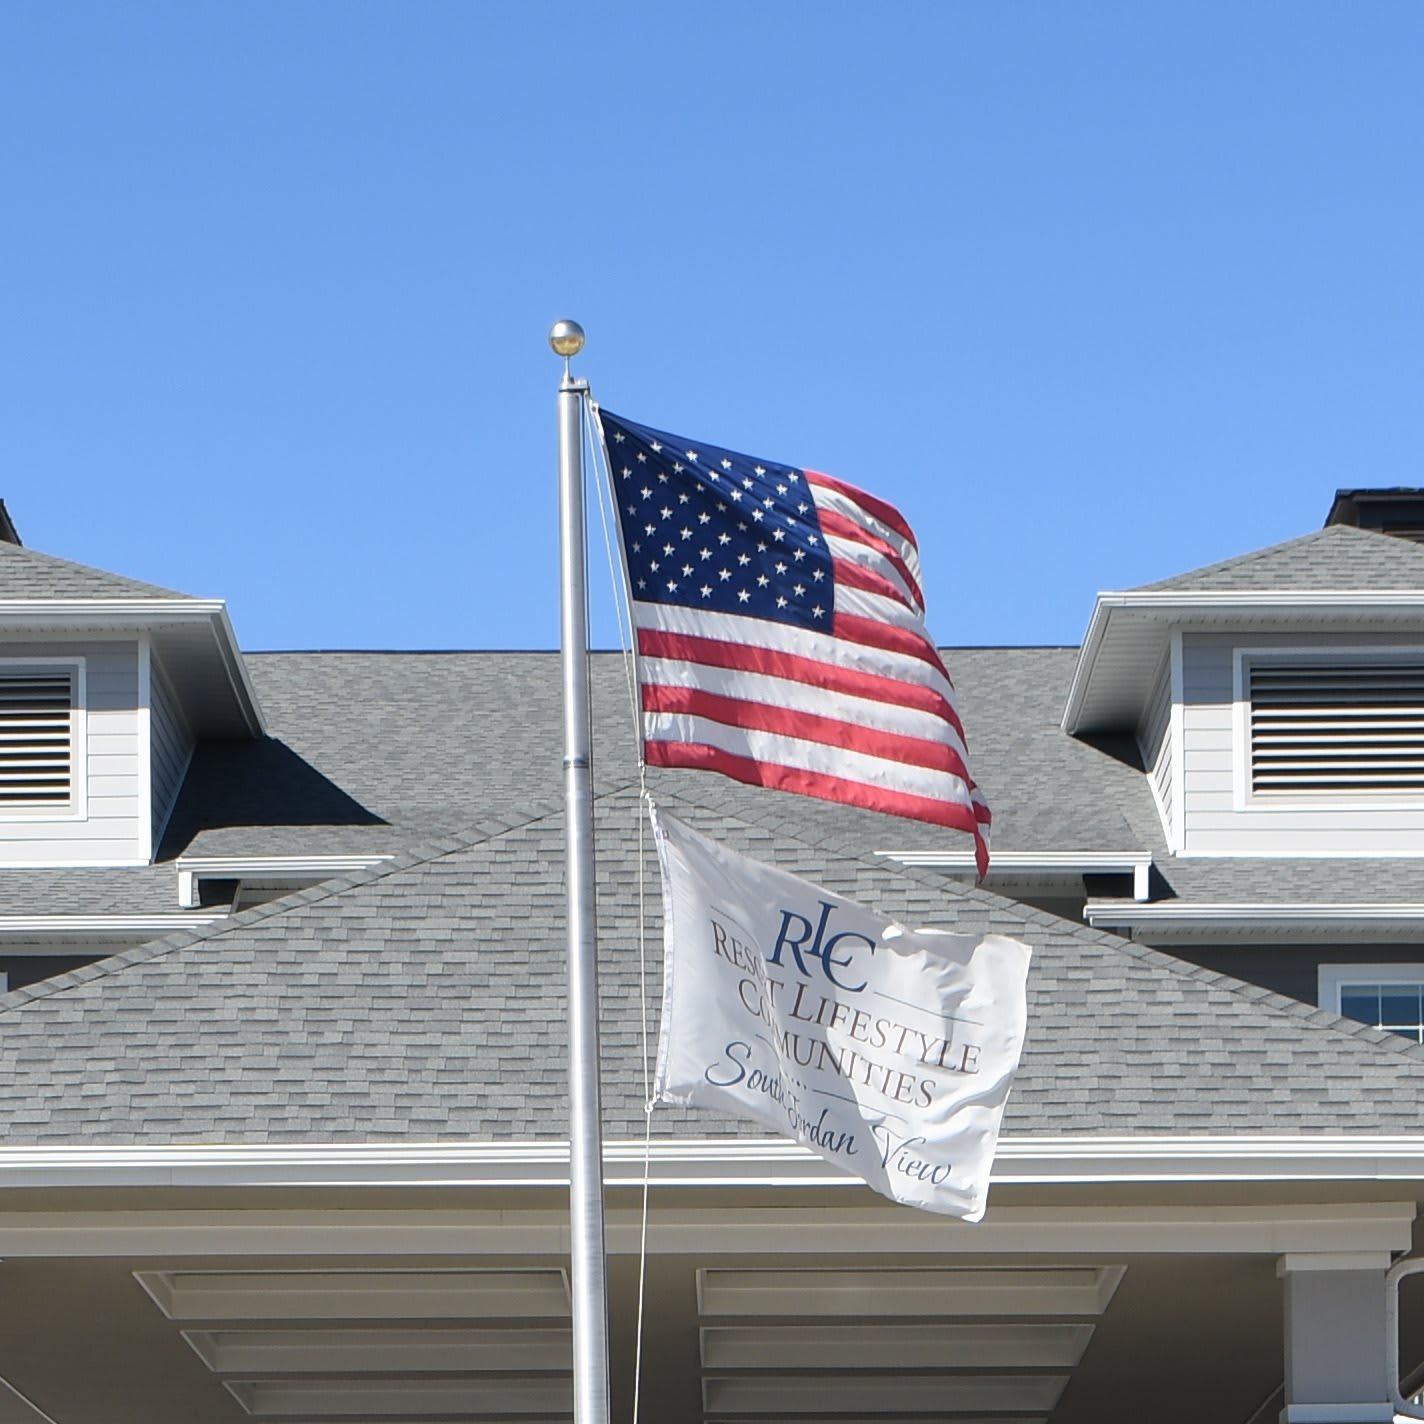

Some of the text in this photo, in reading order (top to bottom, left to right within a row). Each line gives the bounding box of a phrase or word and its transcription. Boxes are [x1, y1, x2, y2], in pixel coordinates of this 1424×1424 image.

[770, 900, 876, 993] RLC
[710, 919, 982, 1075] RESOT LIFESTYLE
[871, 1124, 952, 1186] View
